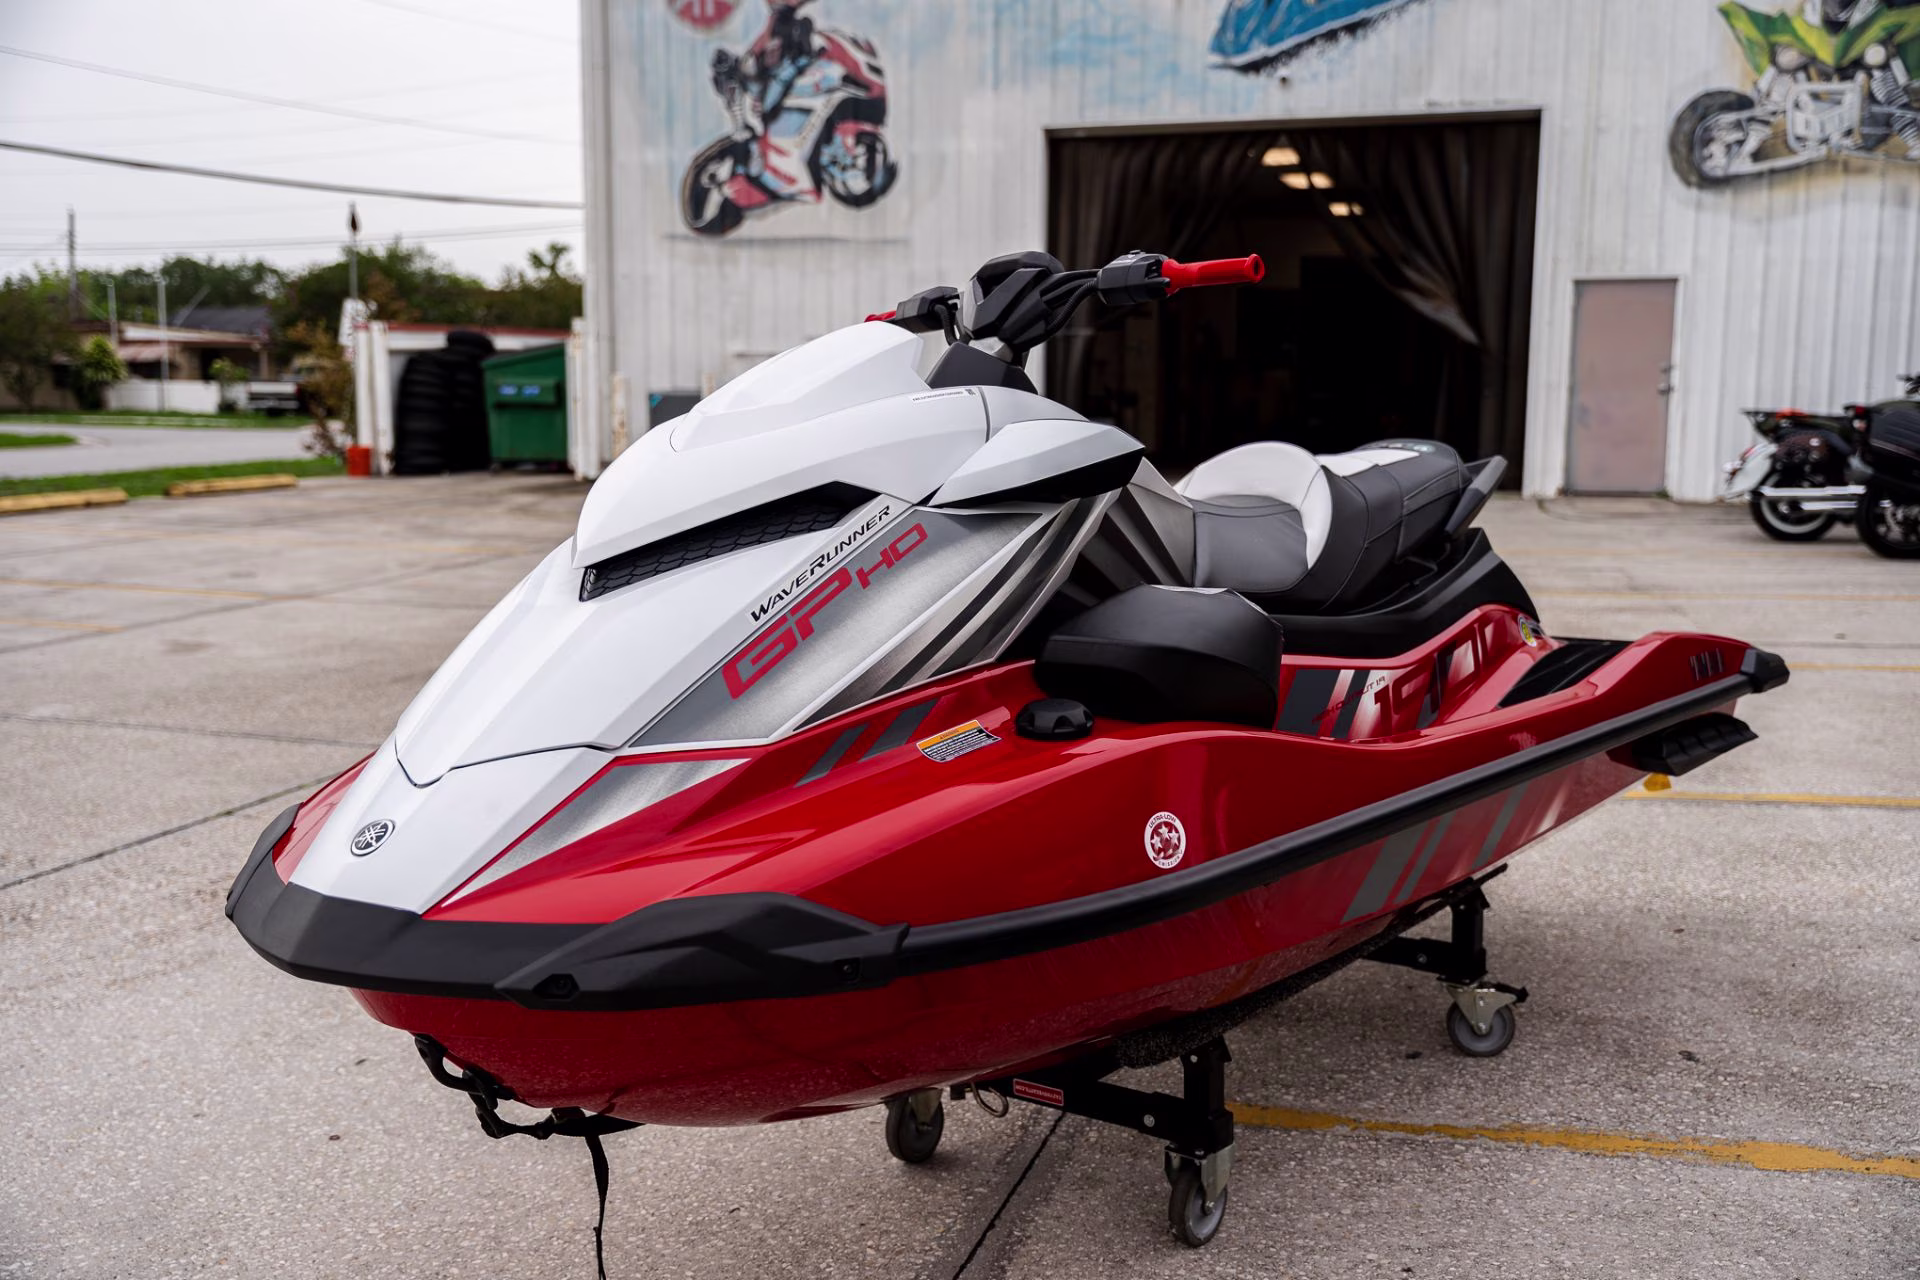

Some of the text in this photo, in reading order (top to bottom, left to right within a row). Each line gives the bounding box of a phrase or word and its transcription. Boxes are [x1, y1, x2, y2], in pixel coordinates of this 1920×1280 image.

[721, 522, 928, 700] GP HO
[750, 505, 890, 622] WAVERUNNER
